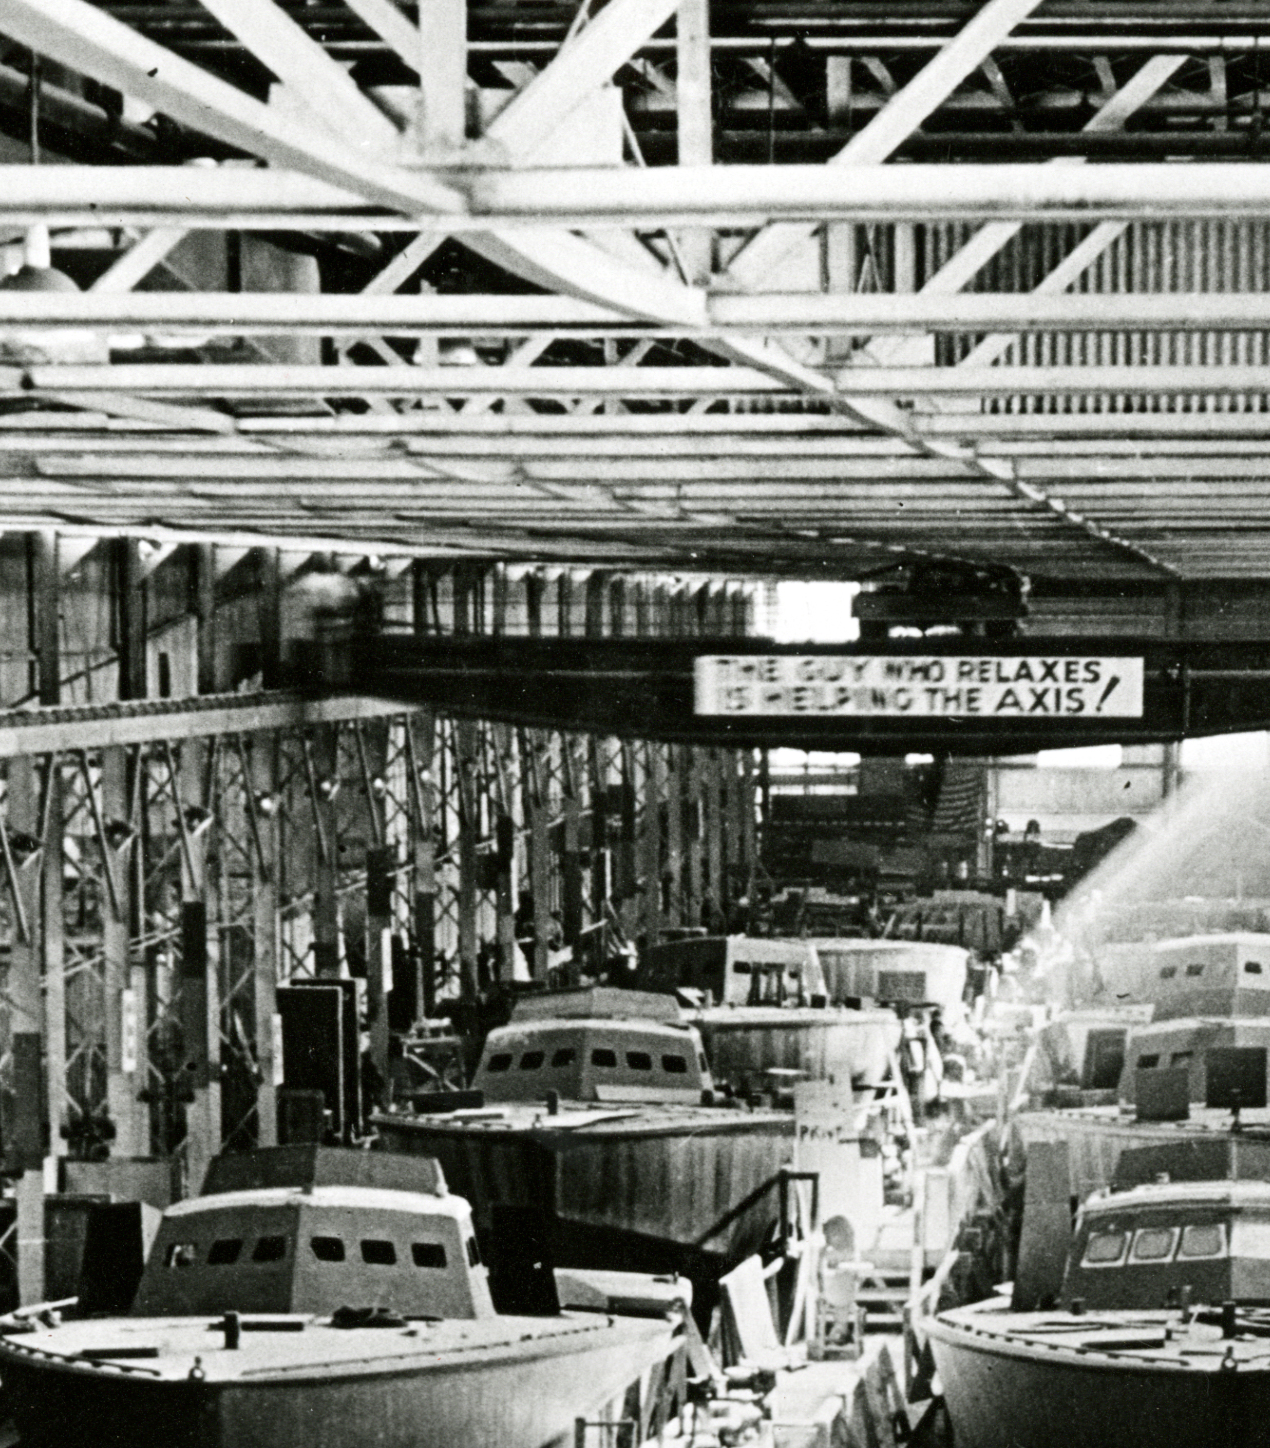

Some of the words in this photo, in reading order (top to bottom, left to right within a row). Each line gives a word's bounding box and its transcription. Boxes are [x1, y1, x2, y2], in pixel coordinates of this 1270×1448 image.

[714, 657, 778, 683] THE
[885, 659, 945, 683] WHO
[958, 659, 1102, 683] RELAXES
[924, 687, 981, 712] THE
[994, 675, 1121, 713] AXIS!
